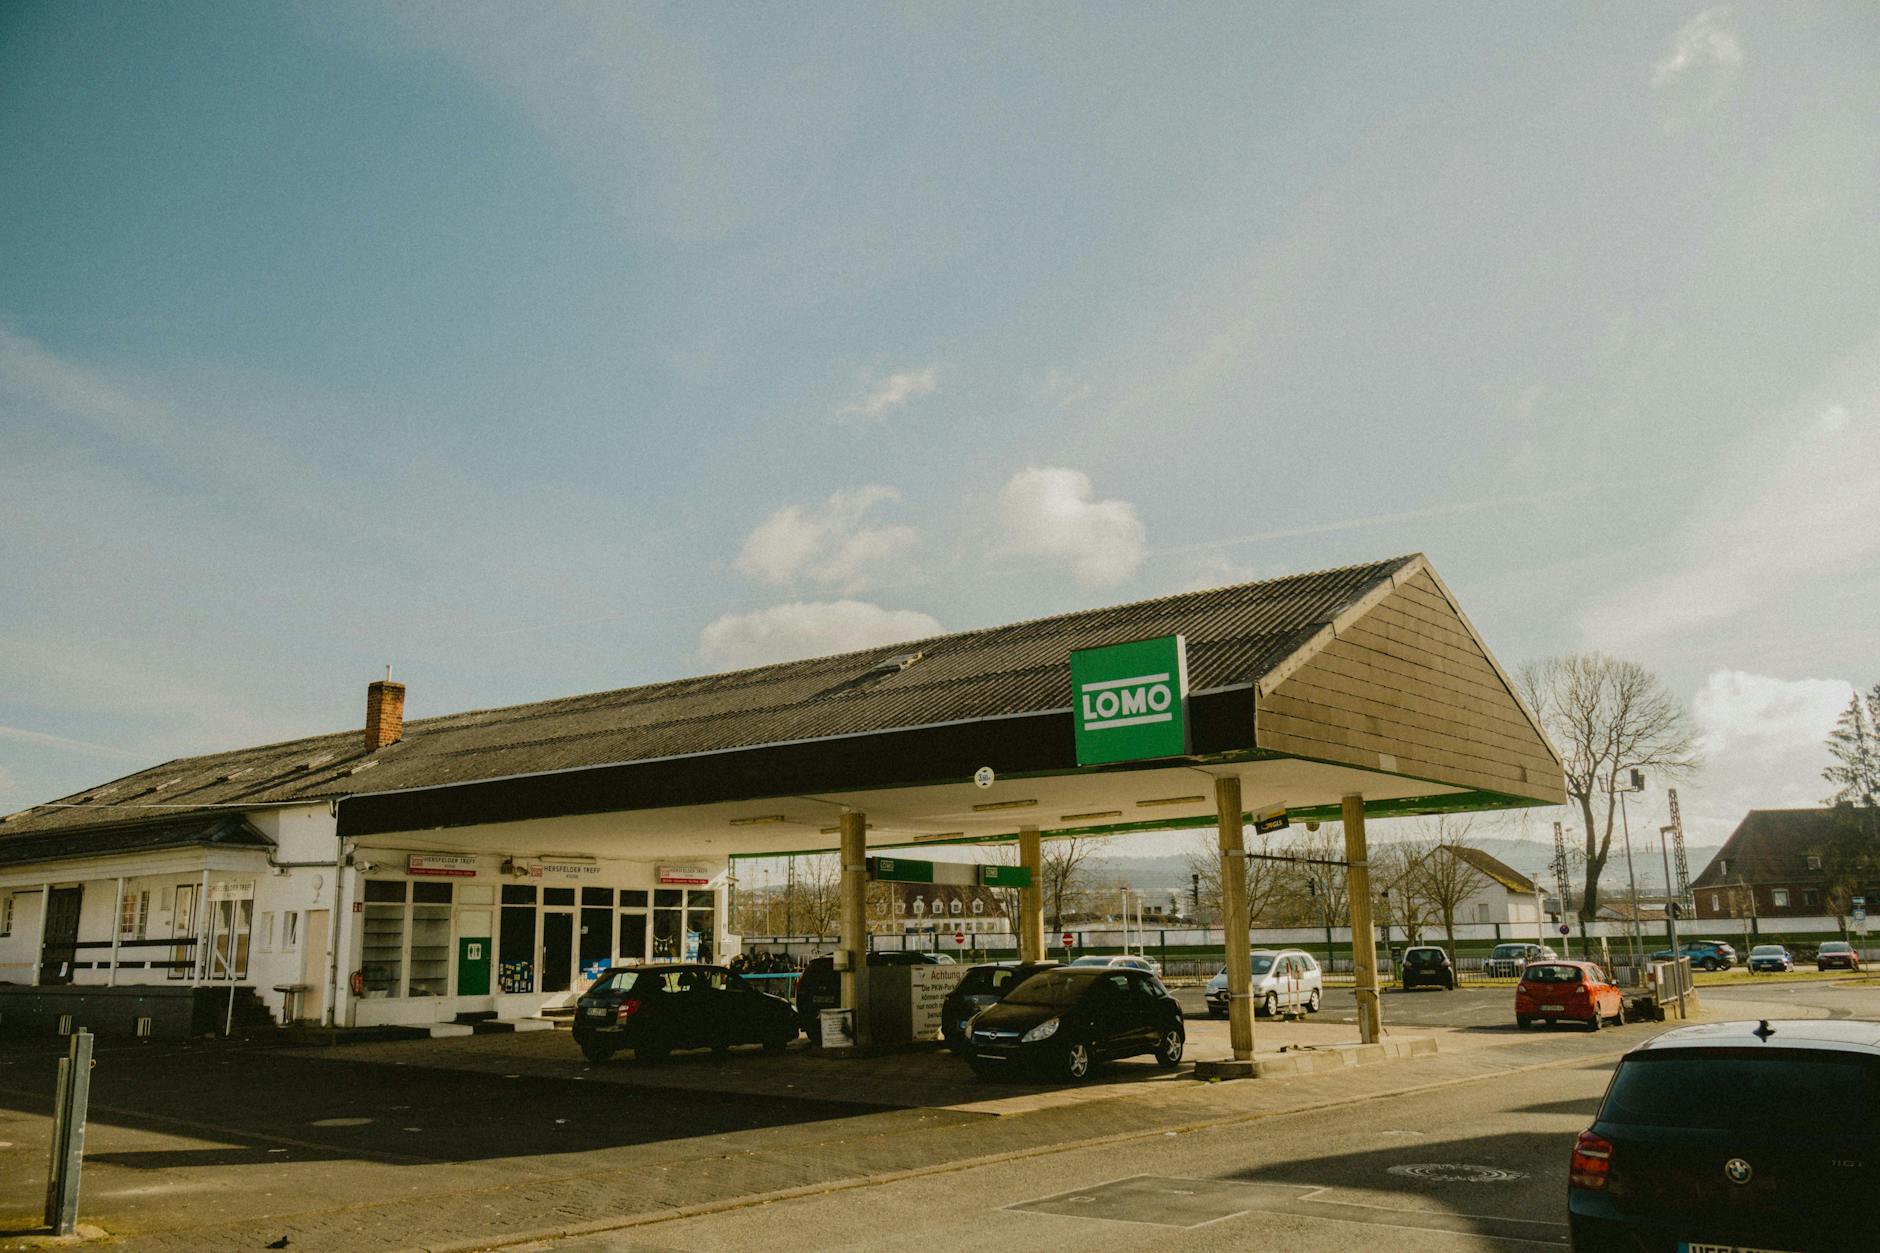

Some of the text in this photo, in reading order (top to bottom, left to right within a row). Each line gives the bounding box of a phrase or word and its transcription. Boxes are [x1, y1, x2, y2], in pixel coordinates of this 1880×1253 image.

[1082, 684, 1172, 720] LOMO
[931, 970, 961, 981] Achtung
[921, 983, 955, 992] Die PKW-Park
